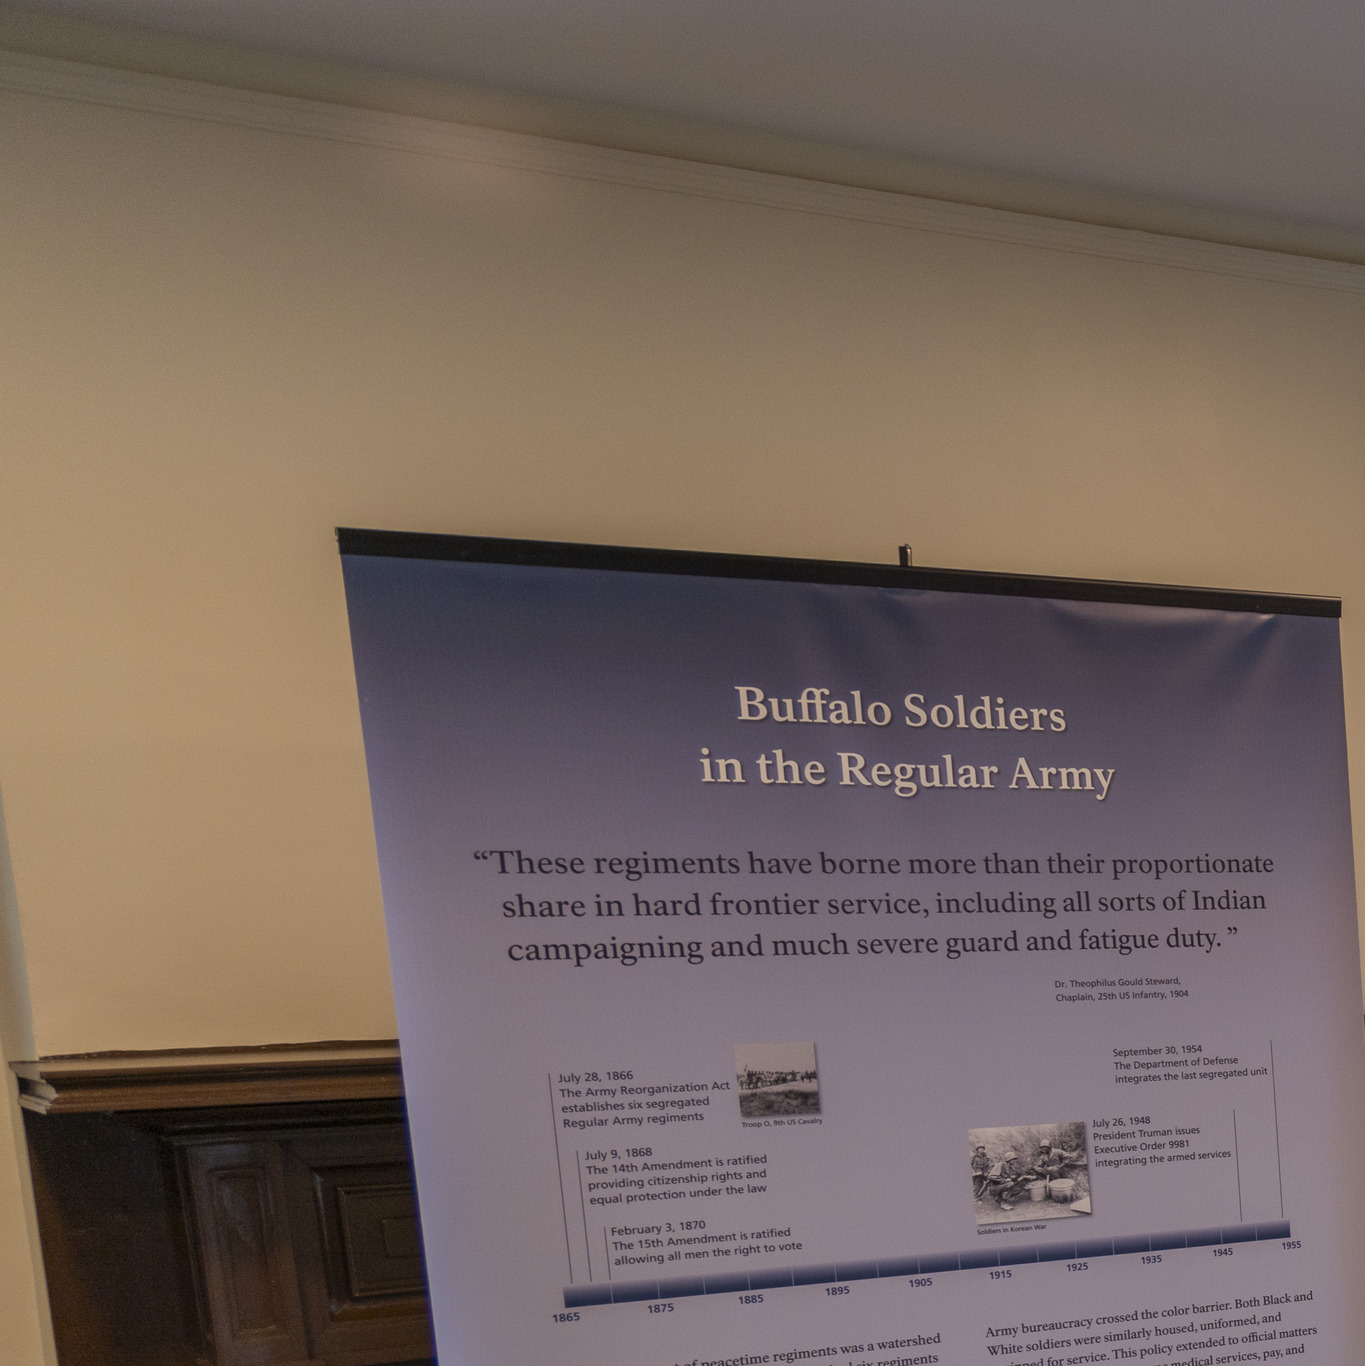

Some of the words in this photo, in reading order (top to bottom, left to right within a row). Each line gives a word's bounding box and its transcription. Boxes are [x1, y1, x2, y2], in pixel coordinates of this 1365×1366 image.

[734, 686, 891, 725] Buffalo
[904, 694, 1066, 731] Soldiers
[700, 748, 745, 782] in
[756, 749, 825, 784] the
[837, 752, 998, 797] Regular
[1009, 757, 1115, 800] Army
[474, 850, 585, 874] “These
[594, 851, 740, 881] regiments
[747, 851, 812, 874] have
[819, 852, 900, 874] borne
[907, 858, 977, 875] more
[983, 852, 1040, 874] than
[1047, 852, 1105, 874] their
[1112, 853, 1274, 880] proportionate
[503, 894, 586, 918] share
[594, 894, 624, 916] in
[632, 892, 702, 916] hard
[710, 892, 820, 915] frontier
[828, 893, 929, 918] service,
[936, 891, 1057, 919] including
[1063, 891, 1091, 912] all
[1098, 894, 1156, 912] sorts
[1163, 890, 1186, 911] of
[1192, 890, 1266, 910] Indian
[508, 936, 704, 967] campaigning
[711, 934, 764, 957] and
[772, 932, 850, 956] much
[857, 938, 938, 954] severe
[946, 930, 1019, 959] guard
[1027, 929, 1072, 951] and
[1079, 928, 1159, 955] fatigue
[1069, 978, 1117, 989] Theophilus
[1117, 977, 1144, 987] Gould
[557, 1072, 581, 1085] July
[605, 1069, 635, 1081] 1866
